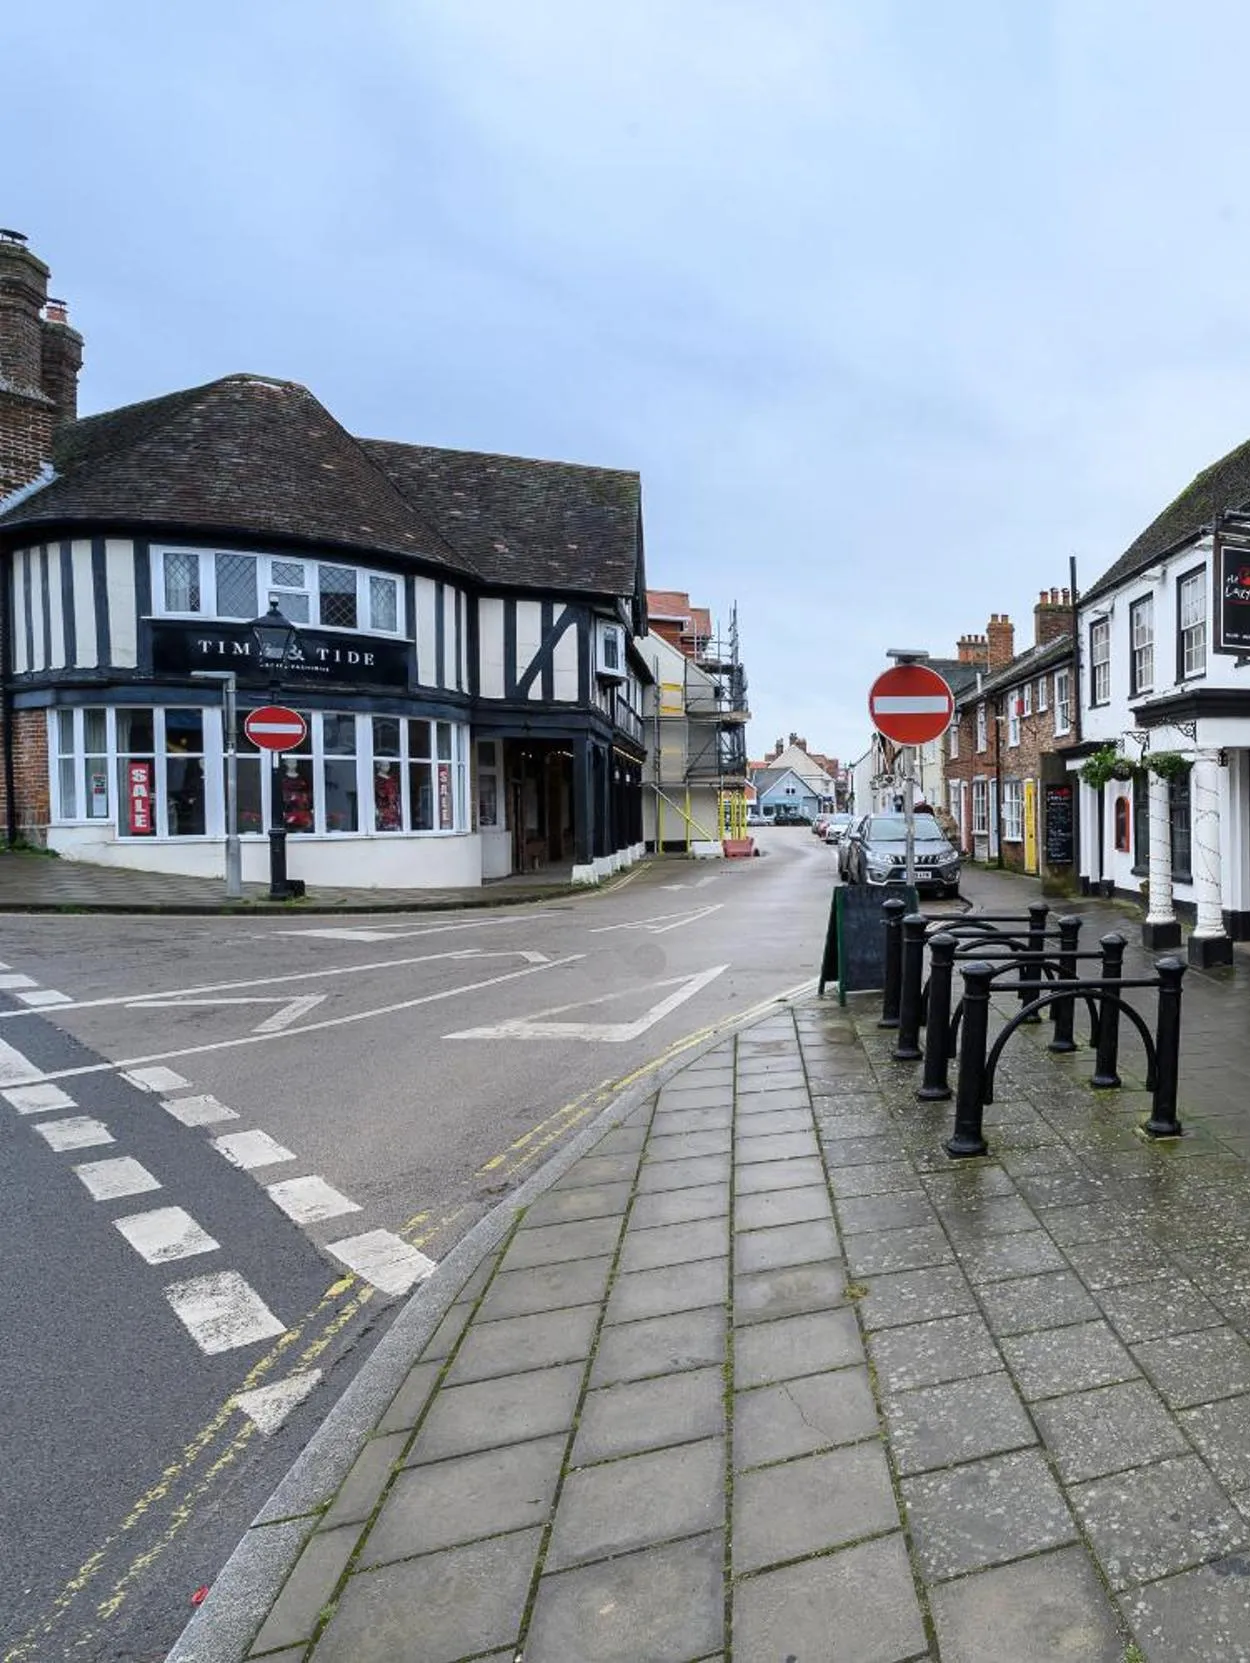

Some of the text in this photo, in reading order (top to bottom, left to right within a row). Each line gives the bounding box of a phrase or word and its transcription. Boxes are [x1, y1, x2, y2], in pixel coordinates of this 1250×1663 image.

[198, 640, 270, 657] TIM
[316, 648, 375, 666] TIDE
[132, 768, 149, 828] SALE
